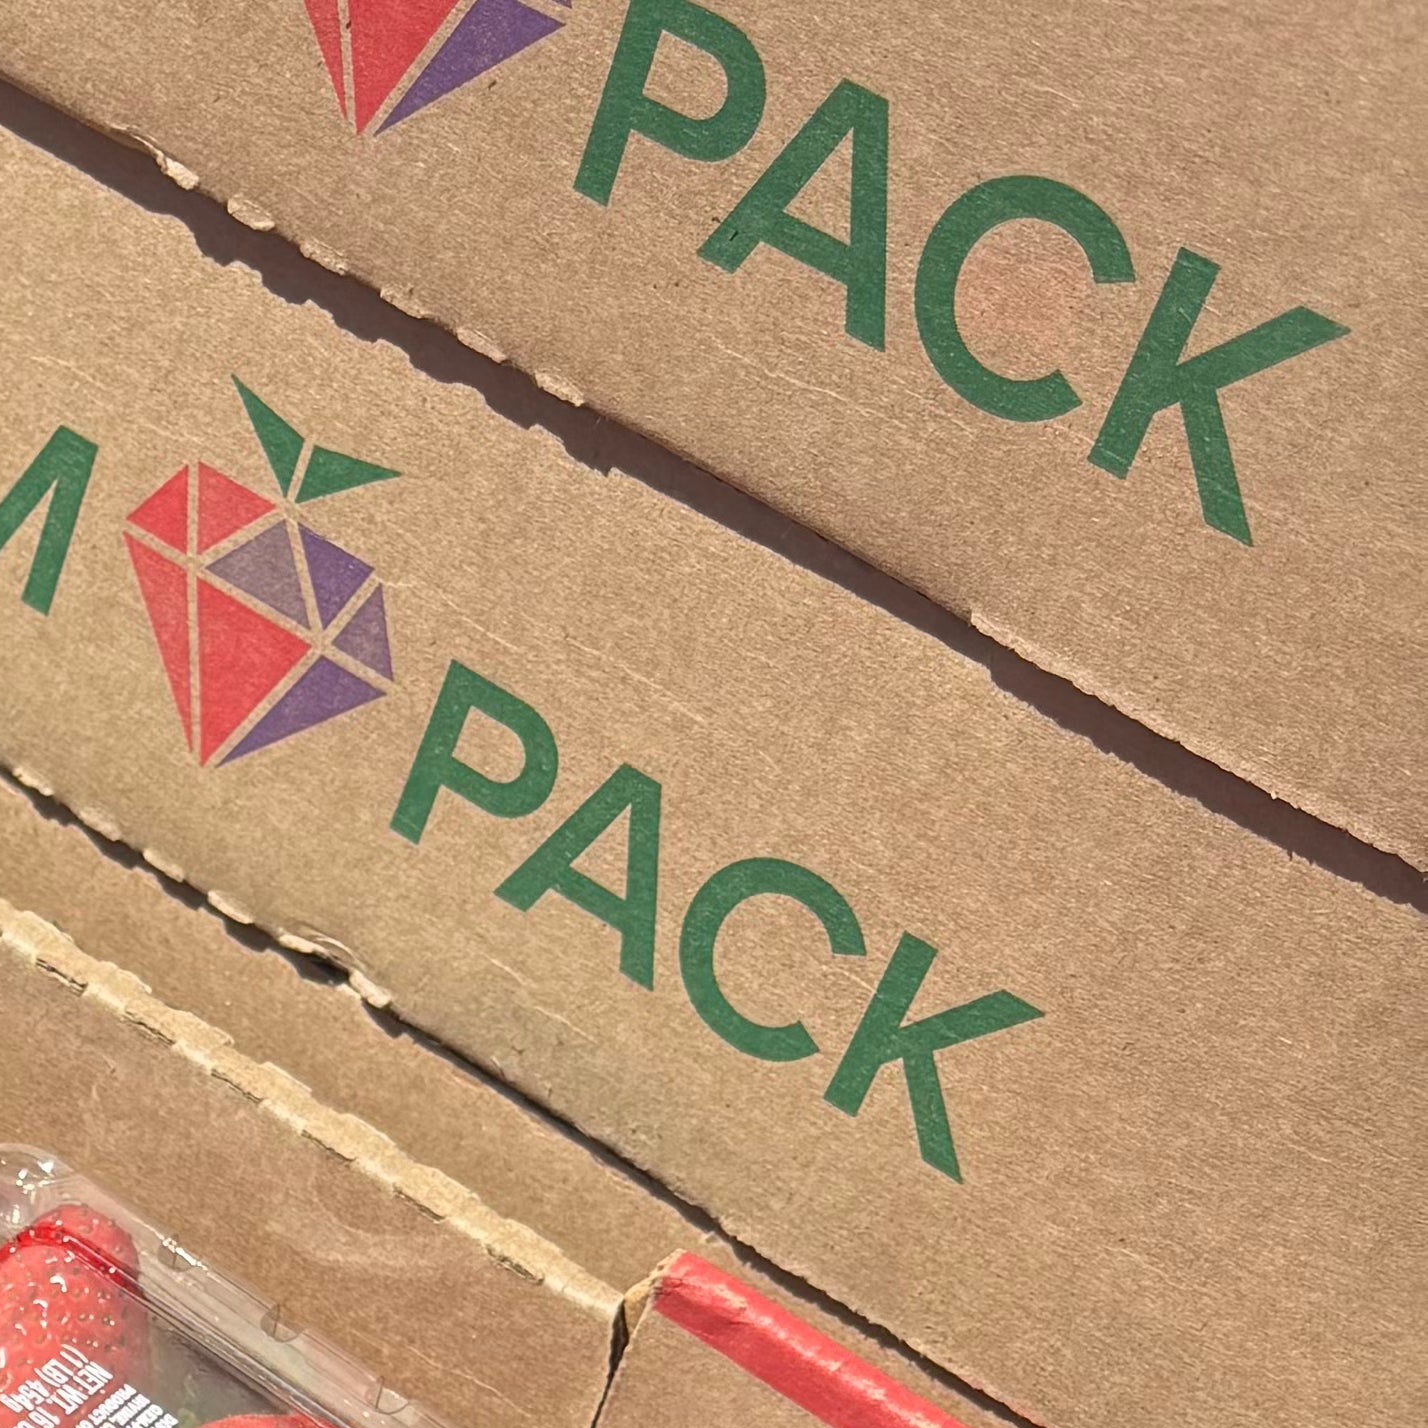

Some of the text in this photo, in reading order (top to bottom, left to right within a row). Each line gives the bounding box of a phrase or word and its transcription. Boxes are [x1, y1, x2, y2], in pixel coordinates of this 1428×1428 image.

[572, 0, 1351, 548] PACK
[389, 659, 1045, 1184] PACK
[33, 1354, 75, 1389] LB)
[70, 1359, 114, 1395] NET
[45, 1380, 89, 1417] WT.
